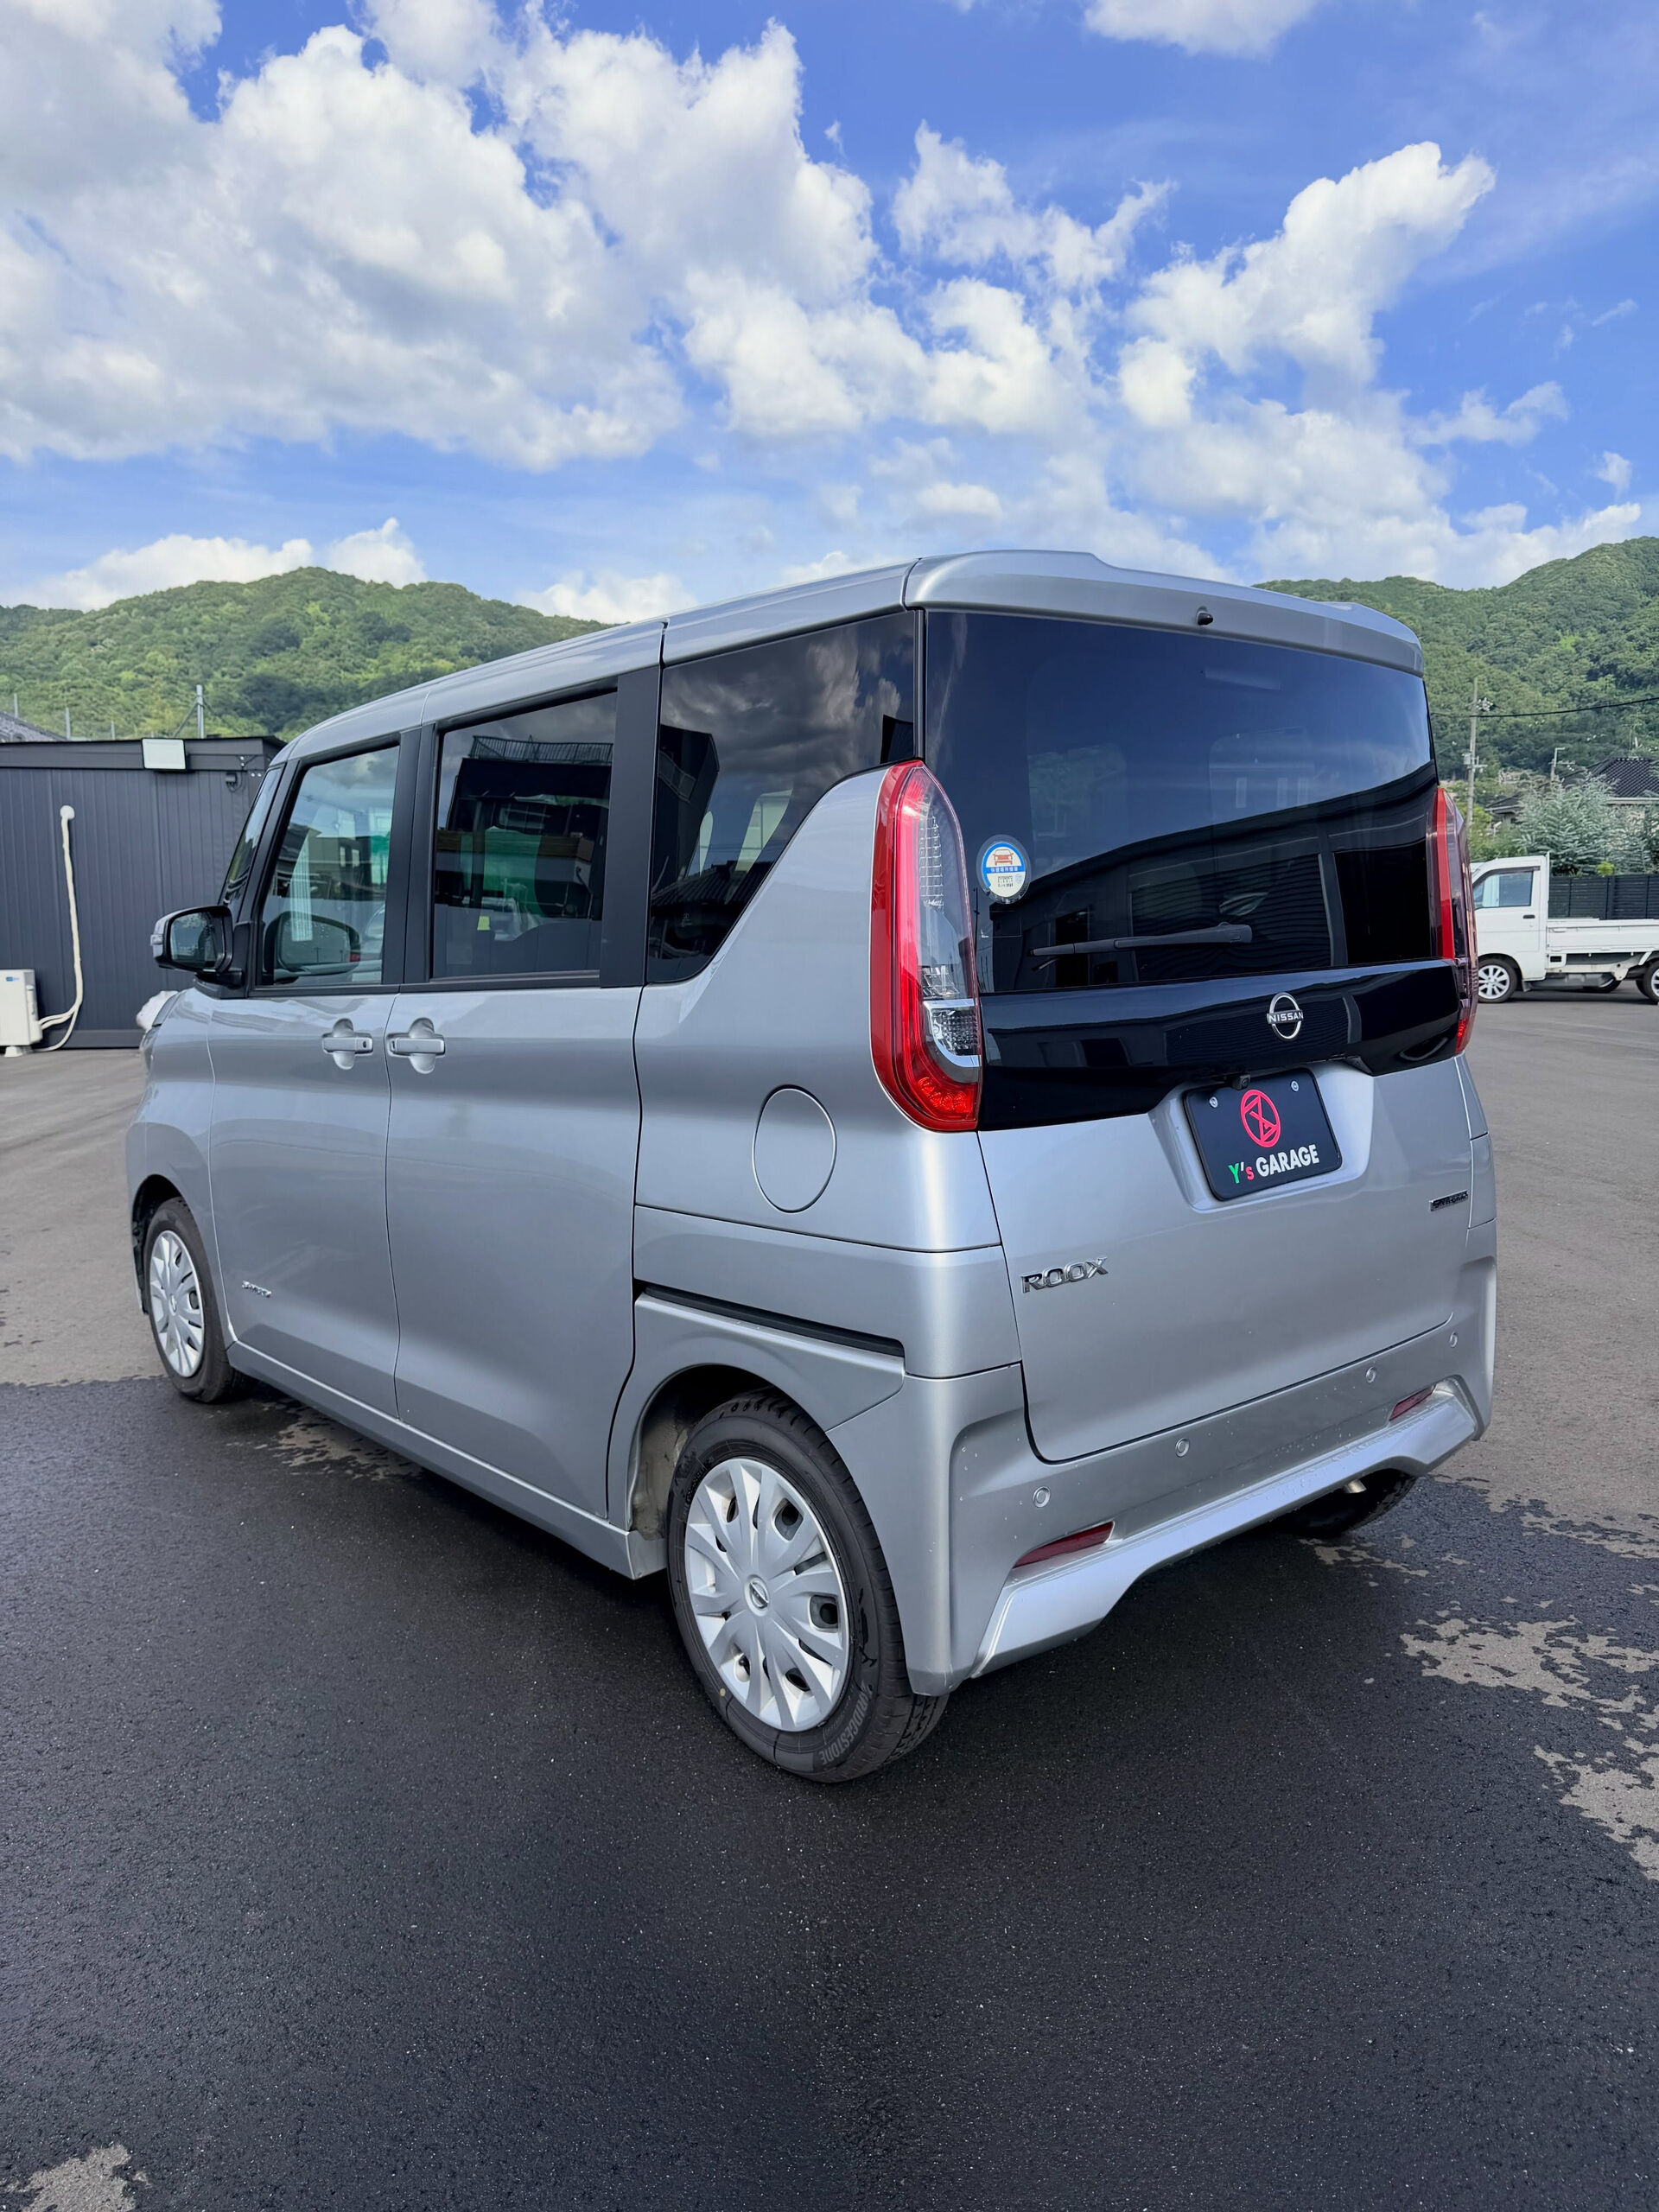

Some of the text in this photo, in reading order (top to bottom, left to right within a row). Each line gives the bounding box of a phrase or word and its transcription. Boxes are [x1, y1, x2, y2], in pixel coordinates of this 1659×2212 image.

[1268, 1011, 1304, 1022] NISSAN
[1228, 1144, 1319, 1184] Y's GARAGE
[1020, 1257, 1109, 1294] ROOX
